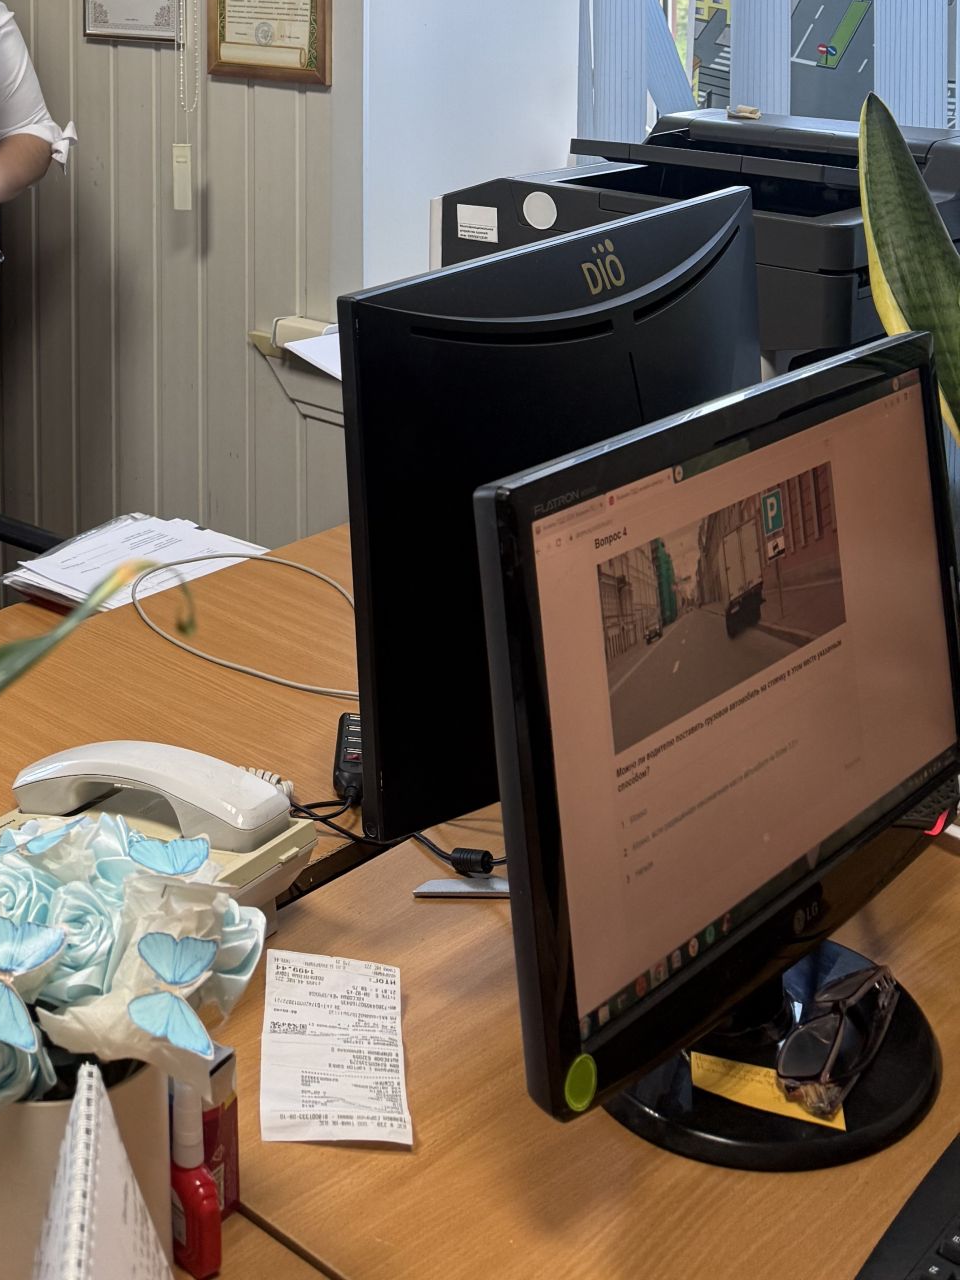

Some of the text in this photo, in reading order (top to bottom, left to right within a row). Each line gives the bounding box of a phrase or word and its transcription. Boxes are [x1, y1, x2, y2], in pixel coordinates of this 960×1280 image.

[534, 488, 580, 516] FLATRON
[594, 526, 627, 549] Вопрос 4
[616, 761, 637, 778] Можно
[637, 756, 646, 766] ли
[646, 738, 675, 761] водителю
[675, 722, 704, 742] поставить
[704, 706, 729, 727] грузовой
[729, 689, 760, 712] автомобиль
[760, 683, 767, 692] на
[803, 655, 817, 668] месте
[617, 766, 650, 793] способом?
[806, 901, 818, 920] LG
